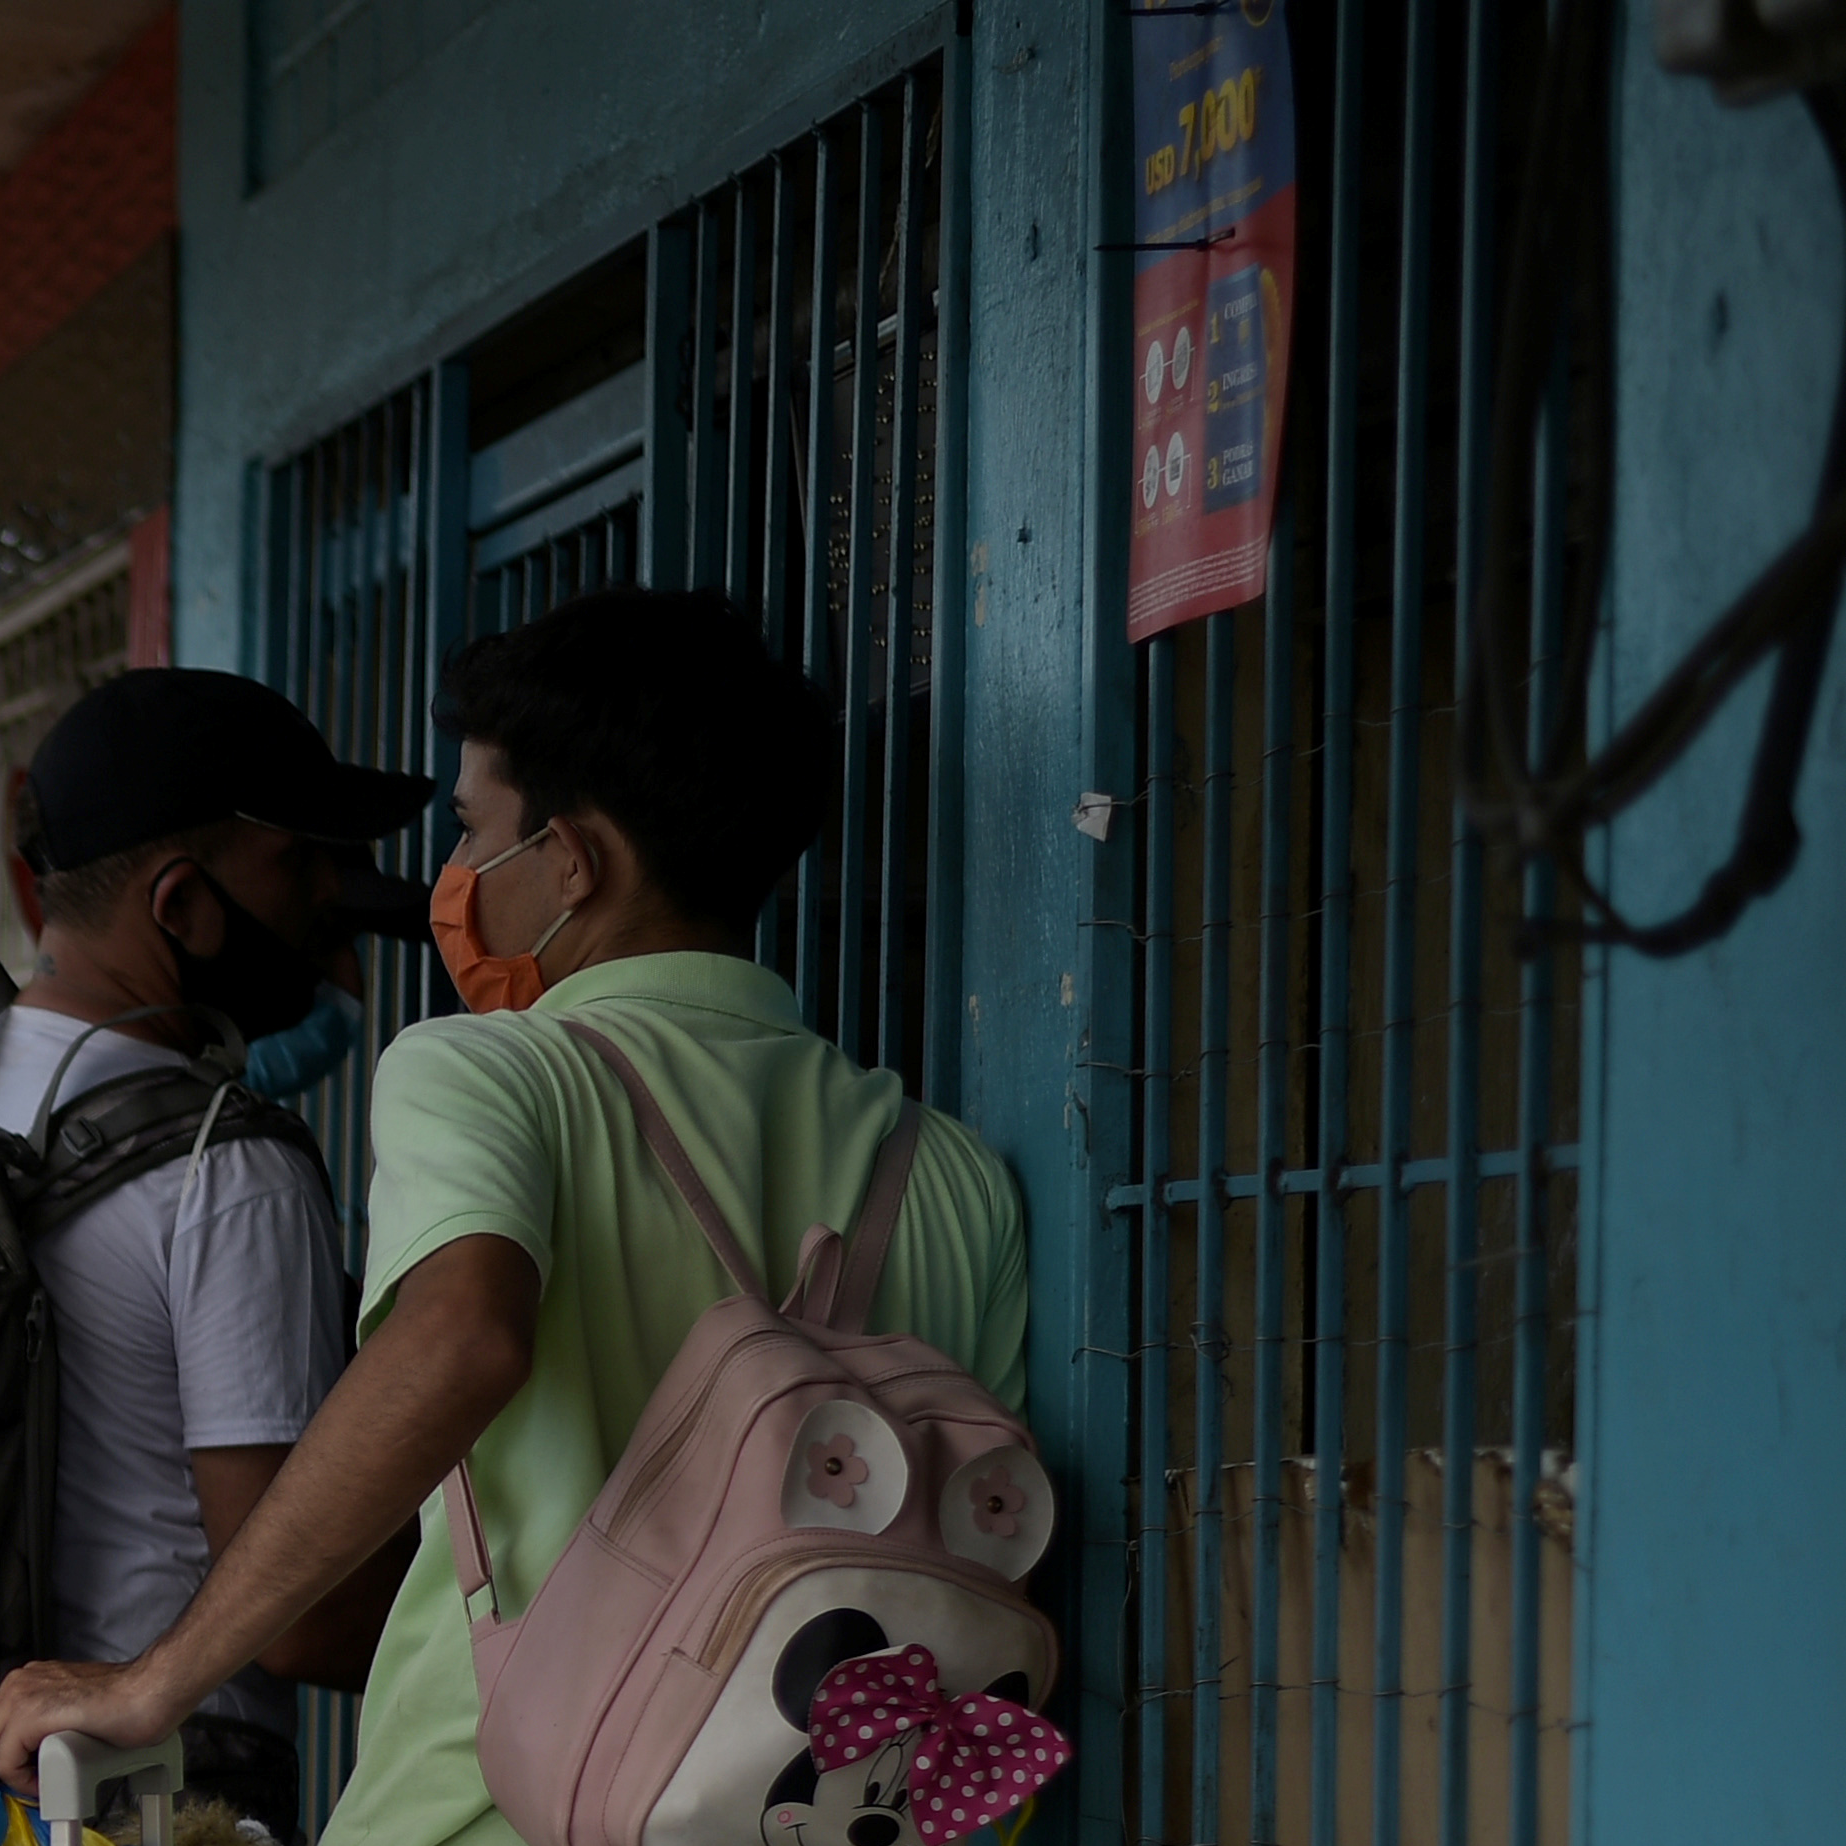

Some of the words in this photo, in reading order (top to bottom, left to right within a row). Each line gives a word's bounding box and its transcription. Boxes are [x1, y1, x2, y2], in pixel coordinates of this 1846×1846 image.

[1145, 145, 1176, 196] USD
[1209, 311, 1220, 344] 1
[1207, 379, 1220, 414] 2
[1207, 456, 1219, 490] 3
